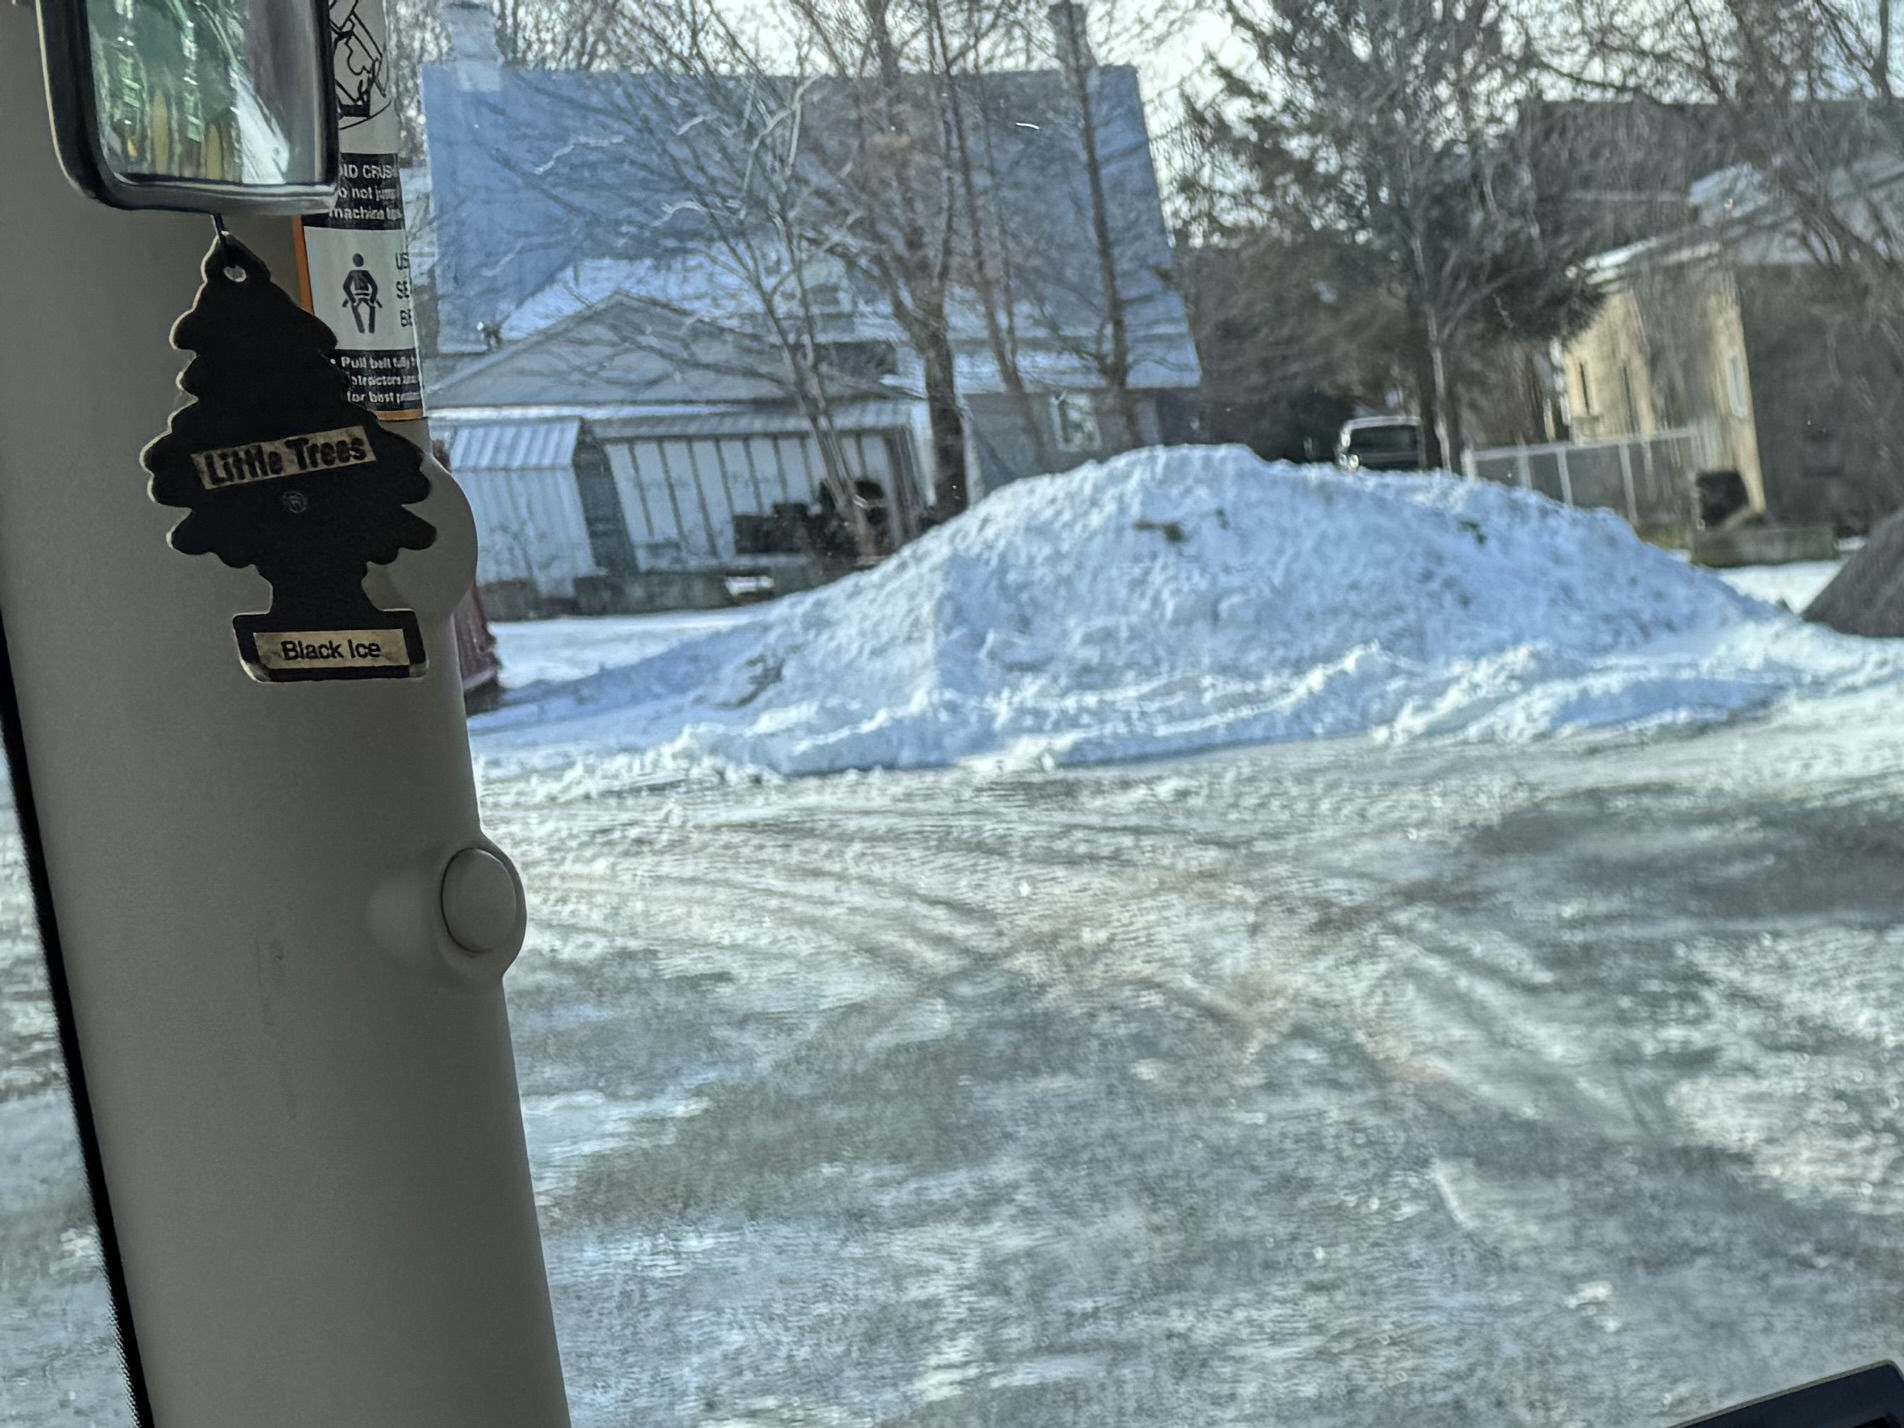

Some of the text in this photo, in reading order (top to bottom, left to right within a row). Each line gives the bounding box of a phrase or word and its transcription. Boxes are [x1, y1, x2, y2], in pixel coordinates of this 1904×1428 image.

[352, 186, 373, 200] not
[341, 356, 367, 369] Pull
[347, 391, 366, 403] for
[204, 437, 367, 487] Little Trees
[281, 640, 381, 661] Black Ice
